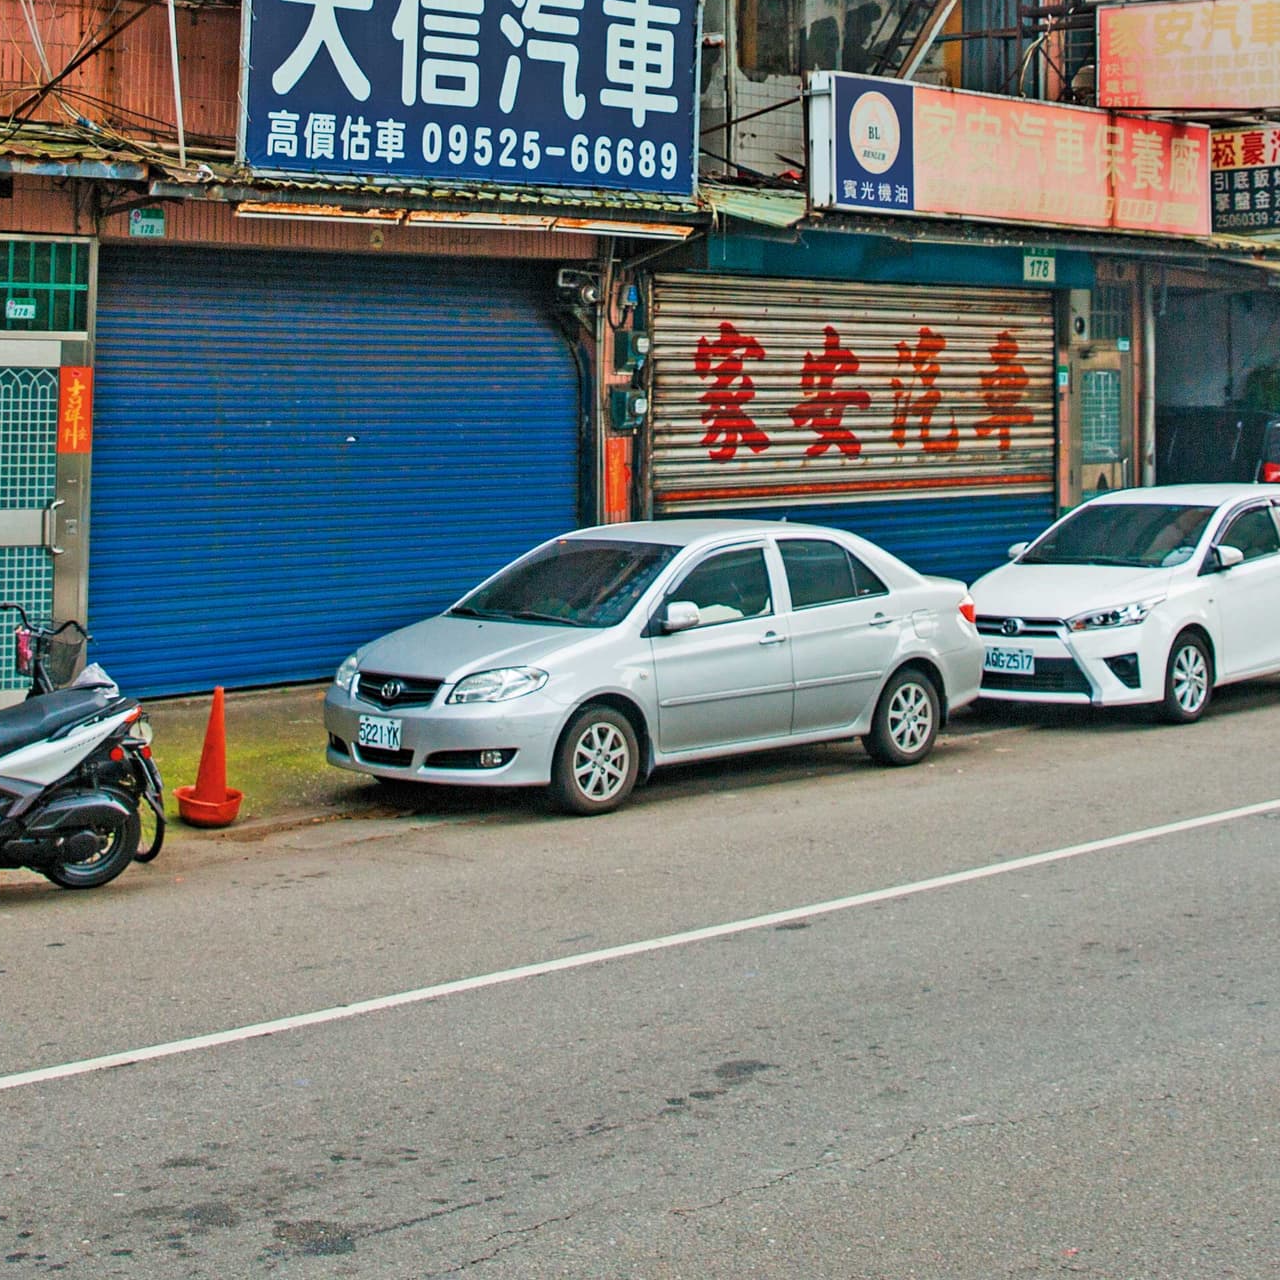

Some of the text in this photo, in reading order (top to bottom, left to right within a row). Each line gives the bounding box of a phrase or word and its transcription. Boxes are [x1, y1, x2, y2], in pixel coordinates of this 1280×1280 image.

[267, 110, 677, 180] 高價估車 09525-66689
[868, 125, 881, 141] BL
[918, 102, 1201, 196] 家安汽車保養廠
[1030, 260, 1049, 278] 178
